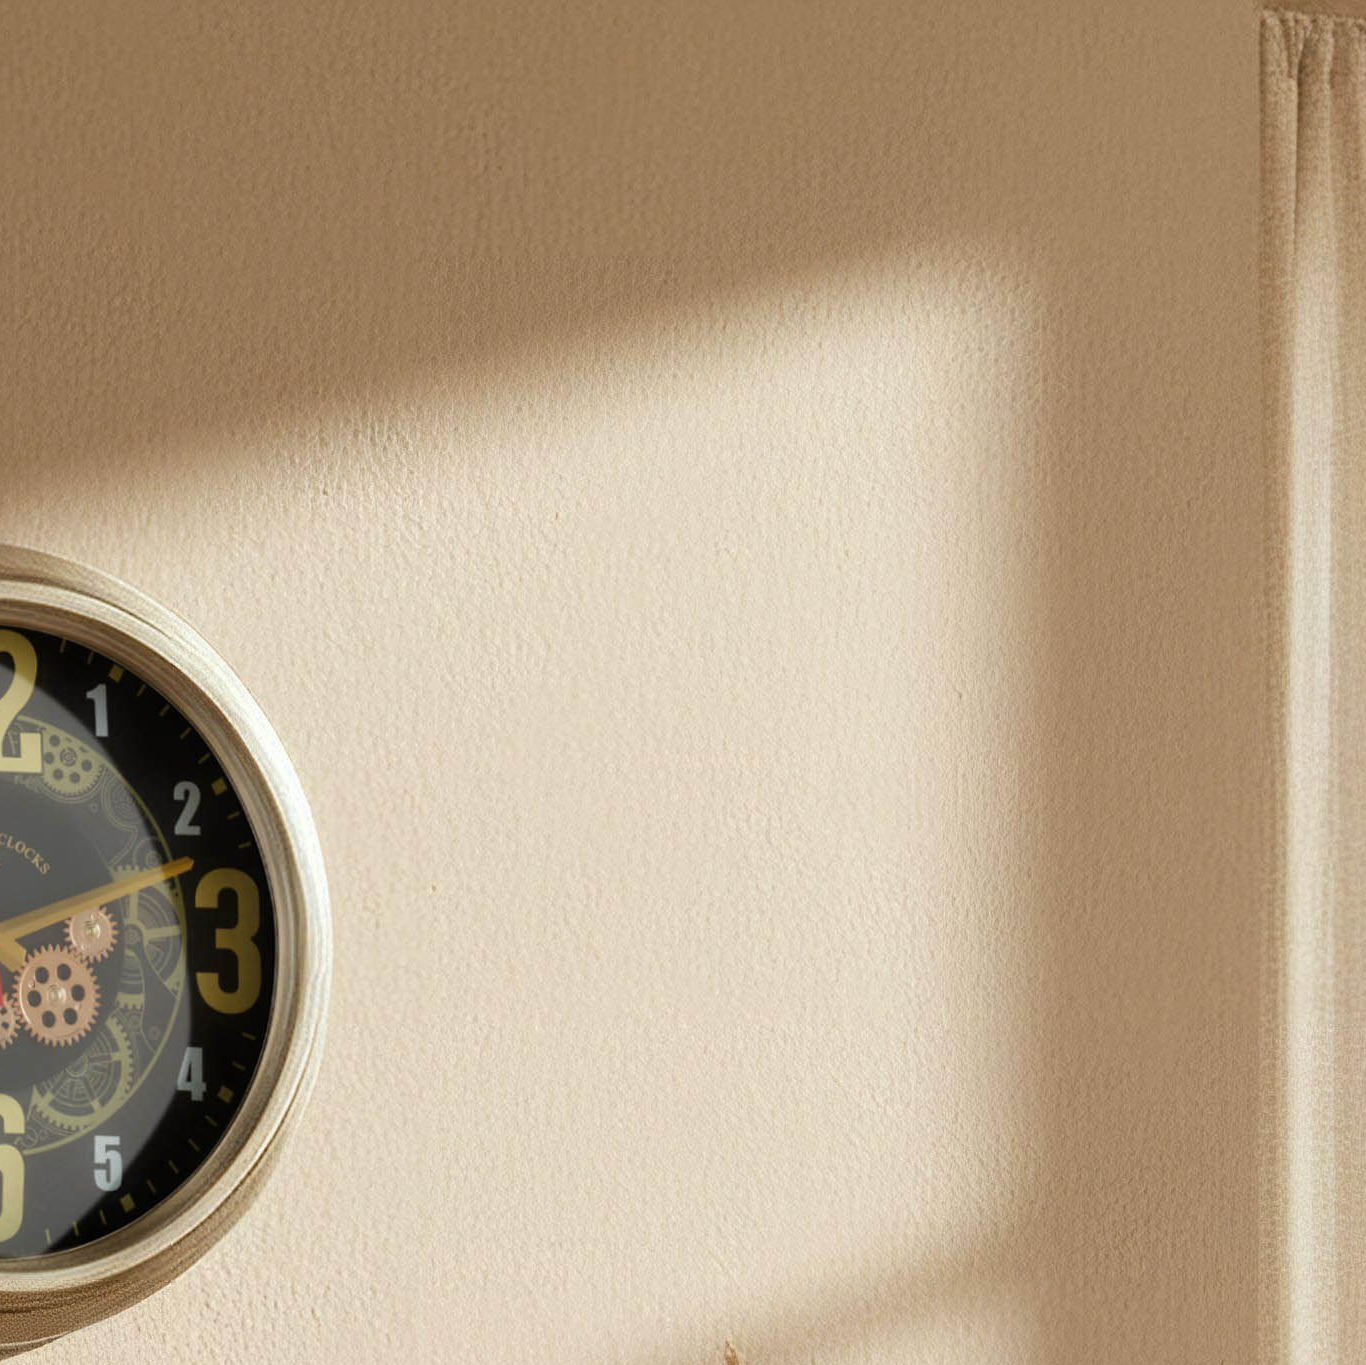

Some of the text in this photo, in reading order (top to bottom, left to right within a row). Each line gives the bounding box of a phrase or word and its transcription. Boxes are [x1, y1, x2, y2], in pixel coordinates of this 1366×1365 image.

[87, 684, 109, 737] 1
[173, 781, 201, 835] 2
[195, 868, 261, 1014] 3
[178, 1047, 206, 1101] 4
[93, 1135, 122, 1191] 5
